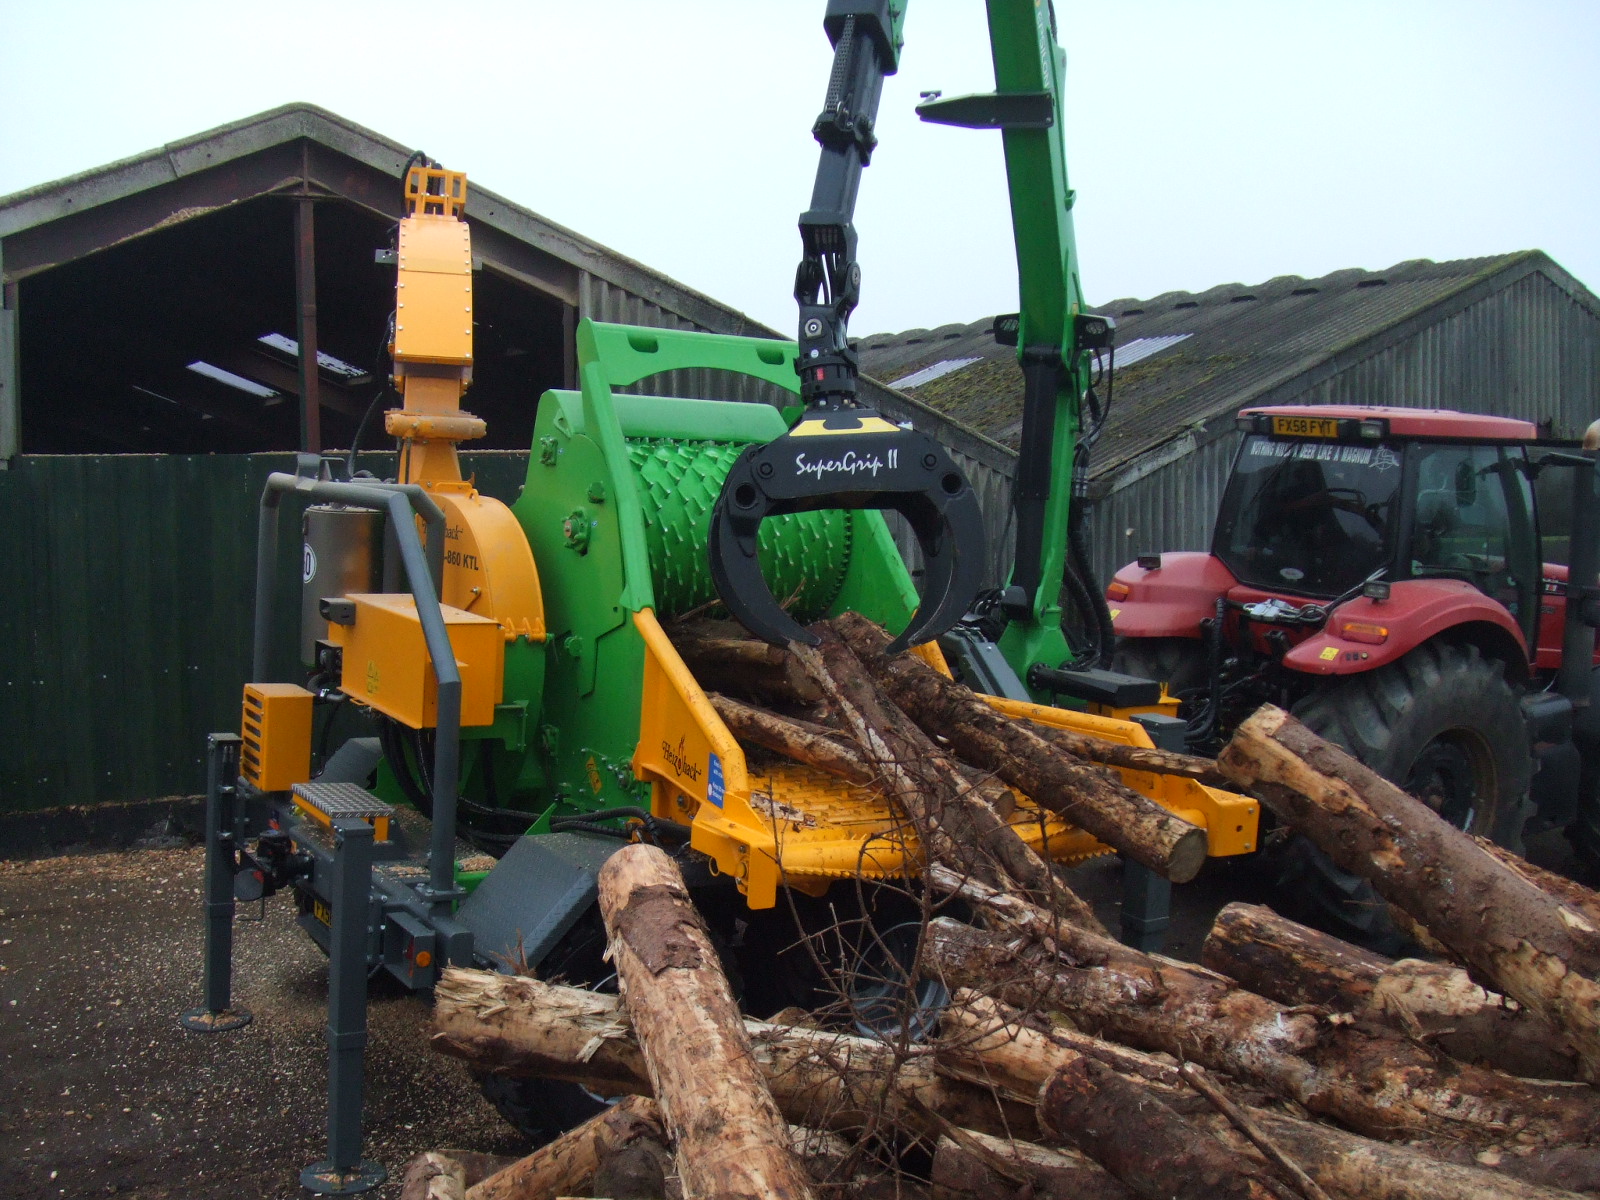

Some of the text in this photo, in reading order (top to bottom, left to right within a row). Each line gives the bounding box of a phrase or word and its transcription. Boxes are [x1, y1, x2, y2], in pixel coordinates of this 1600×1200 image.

[1278, 418, 1307, 433] FX58
[1317, 444, 1334, 461] LIKE
[1334, 445, 1341, 462] A
[795, 451, 883, 480] SuperGrip
[463, 553, 479, 571] KTL
